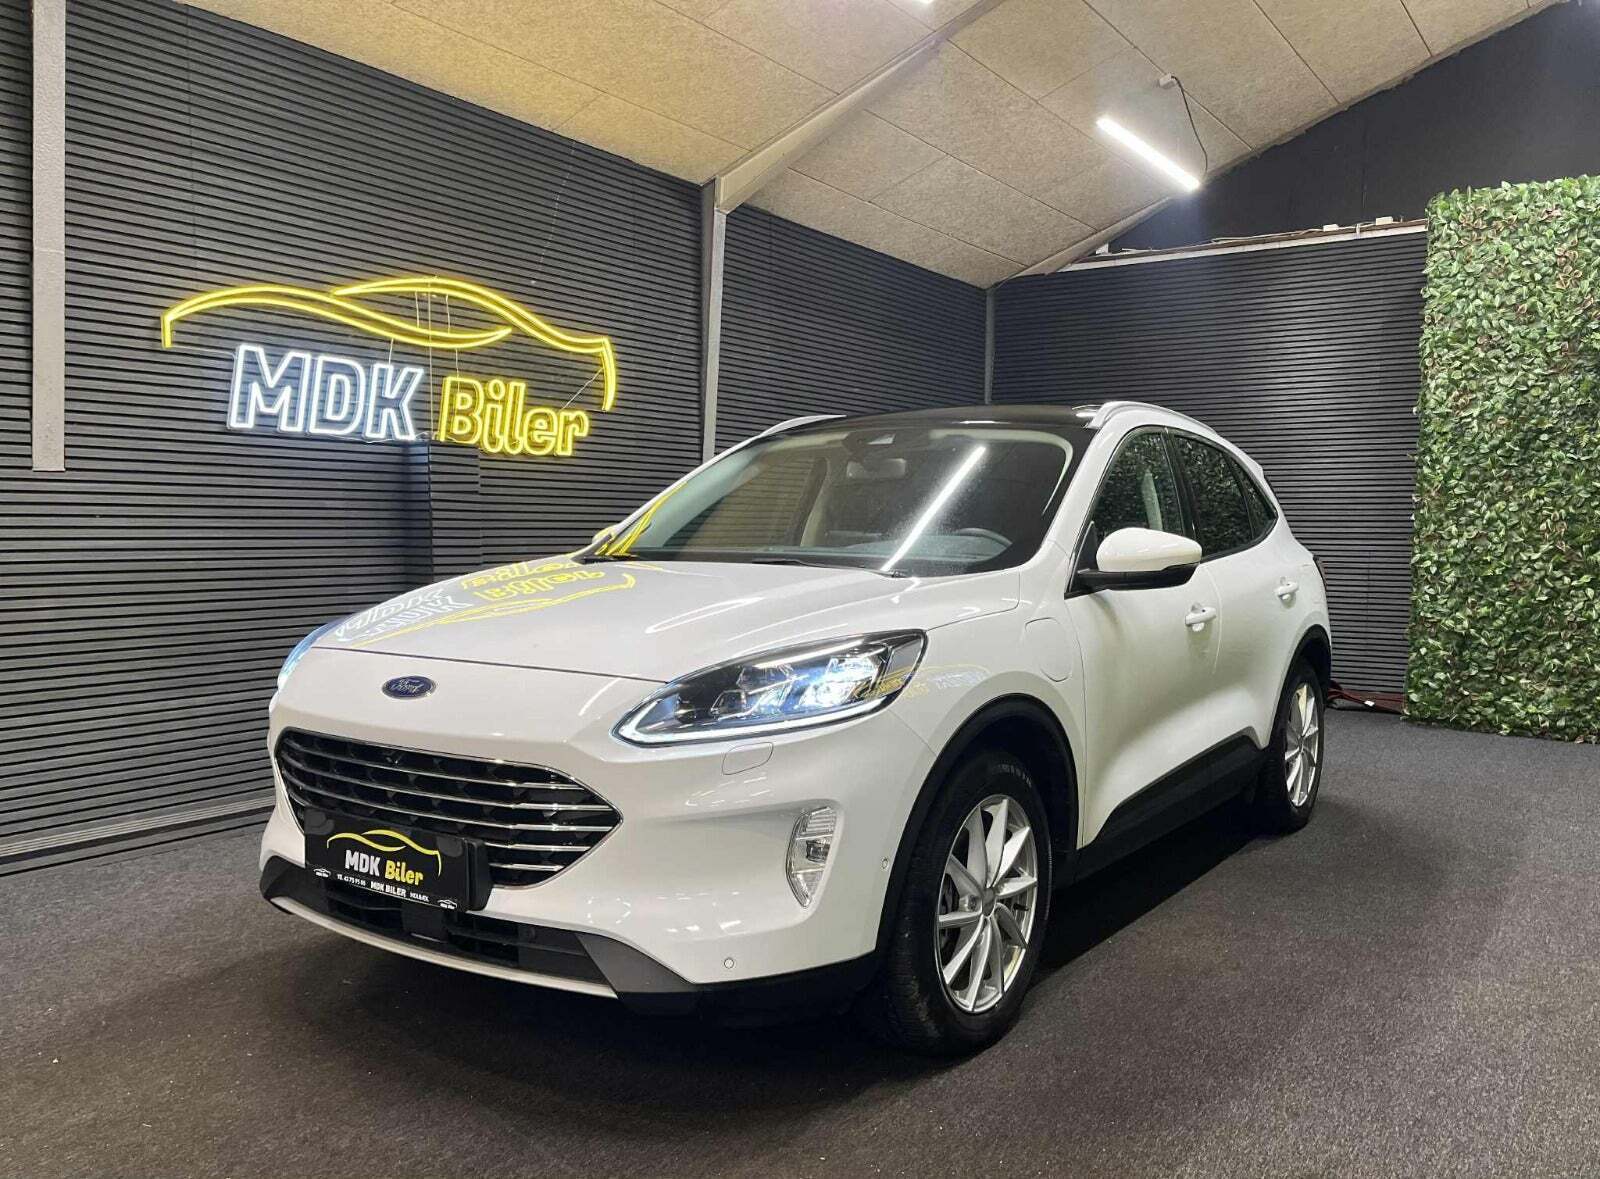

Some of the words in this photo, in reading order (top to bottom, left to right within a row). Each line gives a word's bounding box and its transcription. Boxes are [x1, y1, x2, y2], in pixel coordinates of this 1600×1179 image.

[227, 343, 425, 442] MDK
[437, 375, 591, 457] Biler
[344, 849, 381, 877] MDK
[384, 860, 424, 886] Biler
